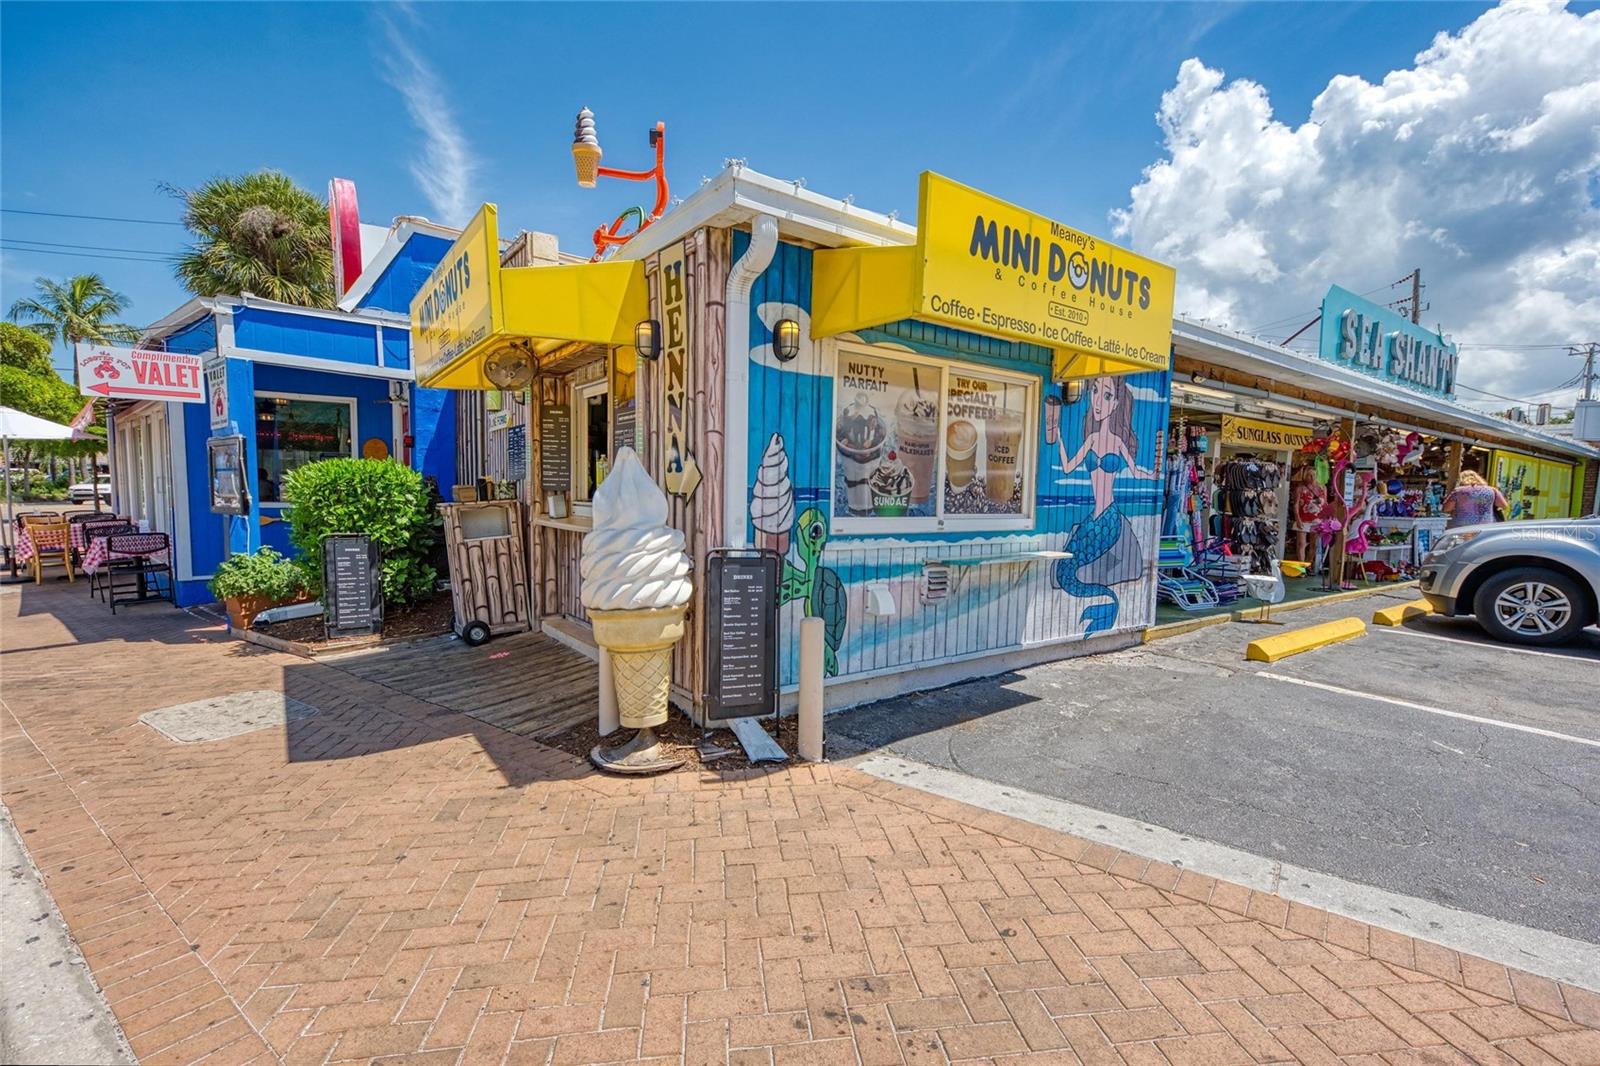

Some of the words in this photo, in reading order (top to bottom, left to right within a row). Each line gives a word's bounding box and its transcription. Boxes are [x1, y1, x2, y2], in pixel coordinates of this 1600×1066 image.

[1051, 222, 1096, 251] Meaney's
[969, 215, 1040, 276] MINI
[1048, 243, 1151, 310] DONUTS
[433, 250, 470, 321] DONUTS
[995, 268, 1003, 281] &
[1018, 275, 1077, 303] Coffee
[1089, 296, 1133, 319] House
[1054, 306, 1067, 318] Est.
[1068, 309, 1084, 322] 2010
[931, 295, 975, 321] Coffee
[982, 308, 1036, 335] Espresso
[1043, 322, 1059, 339] Ice
[1061, 328, 1093, 348] Coffee
[1125, 342, 1138, 357] Ice
[1139, 346, 1166, 365] Cream
[131, 351, 200, 365] Complimentary
[1341, 308, 1384, 369] SEA
[1390, 330, 1458, 395] SHANTY
[132, 361, 200, 388] VALET
[663, 260, 685, 474] HENNA
[848, 362, 885, 379] NUTTY
[843, 376, 888, 393] PARFAIT
[956, 377, 970, 389] TRY
[972, 381, 988, 392] OUR
[1237, 426, 1282, 445] SUNGLASS
[988, 454, 1016, 464] COFFEE
[994, 446, 1010, 455] ICED
[873, 495, 909, 507] SUNDAE
